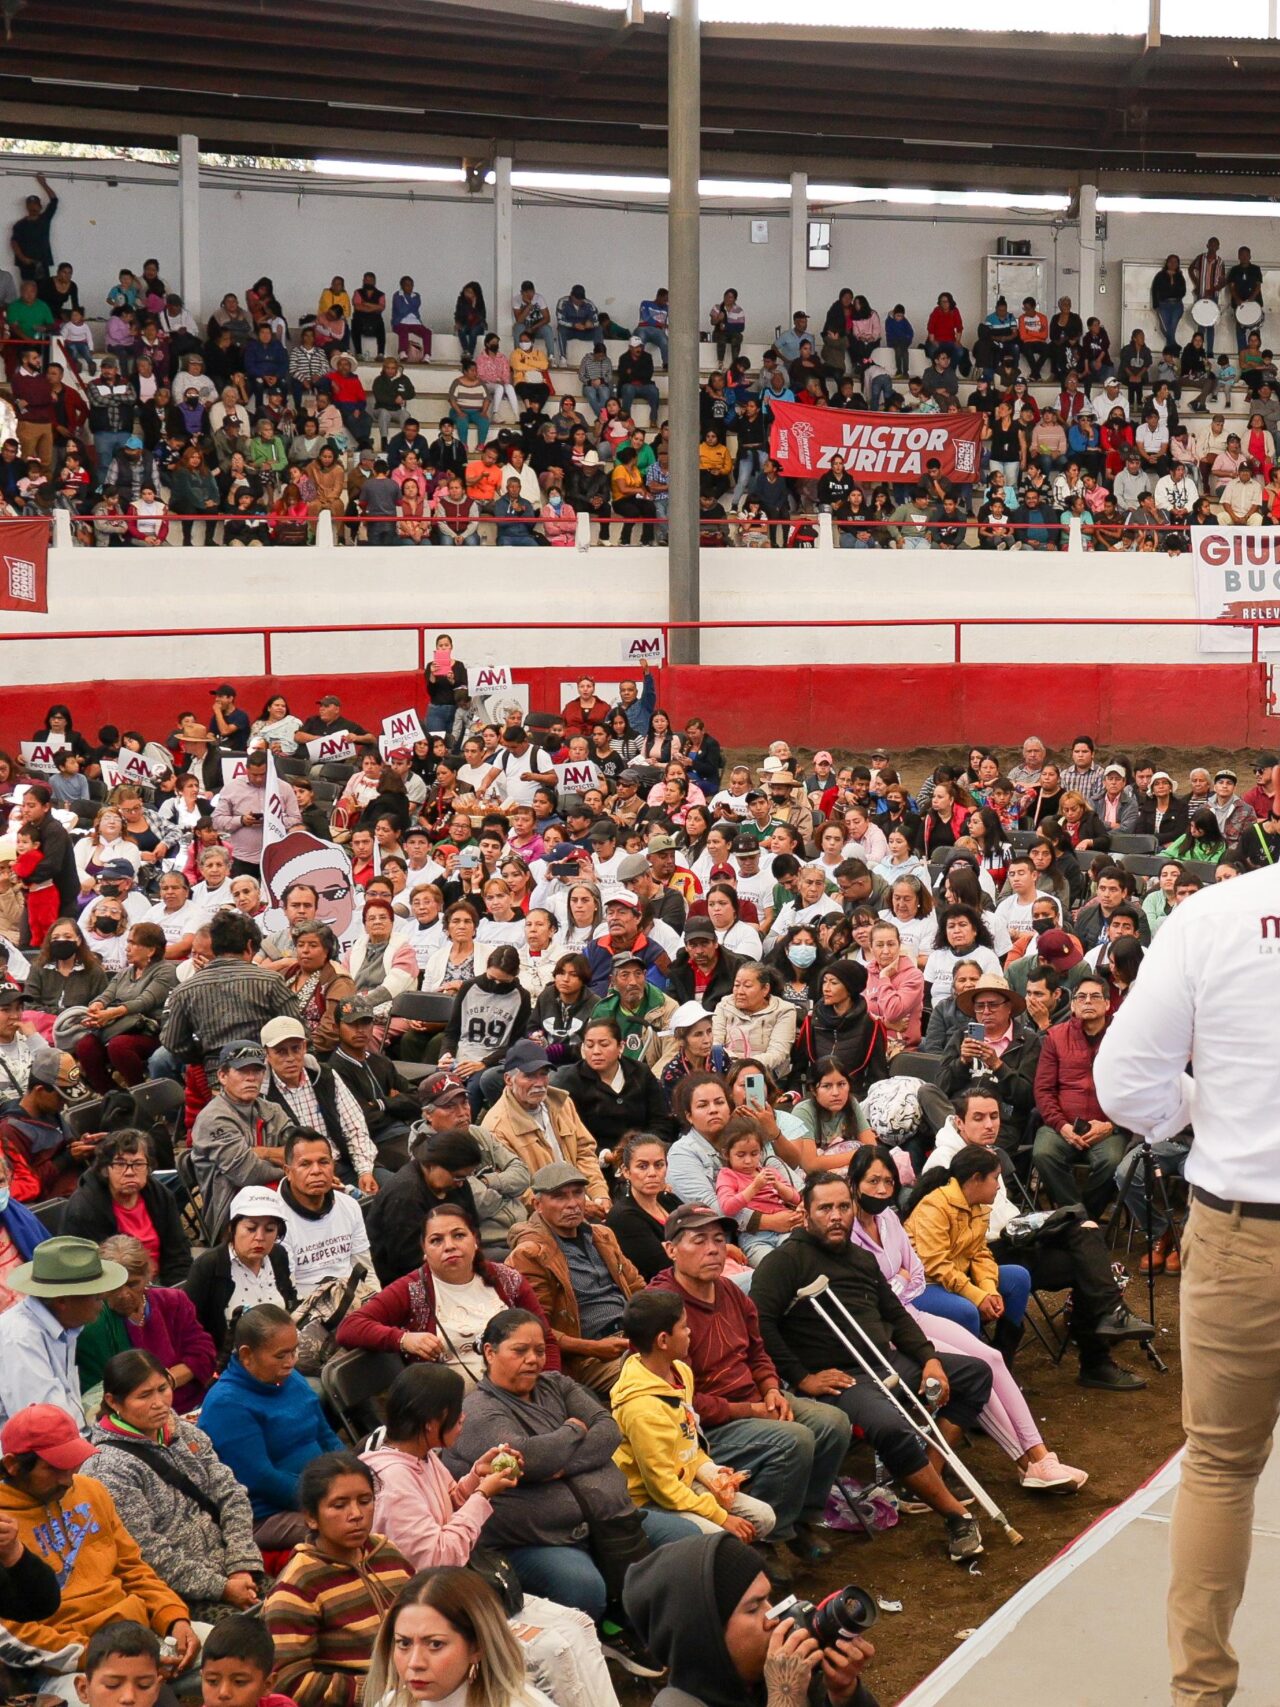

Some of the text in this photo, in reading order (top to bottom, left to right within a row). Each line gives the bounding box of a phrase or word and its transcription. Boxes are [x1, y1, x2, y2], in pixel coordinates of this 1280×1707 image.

[842, 423, 949, 451] VICTOR
[815, 445, 922, 475] ZURITA
[12, 562, 20, 596] TODOS
[20, 562, 28, 598] SOMOS
[628, 651, 661, 659] PROYECTO
[629, 637, 660, 654] AM
[477, 668, 507, 687] AM
[475, 685, 508, 693] PROYECTO
[391, 713, 416, 739] AM
[319, 735, 350, 758] AM
[232, 761, 248, 779] A
[563, 766, 592, 786] AM
[563, 783, 595, 791] PROYECTO
[1259, 945, 1273, 955] La
[468, 1018, 506, 1047] 89
[297, 1255, 309, 1265] LA
[311, 1242, 352, 1262] ESPERANZ
